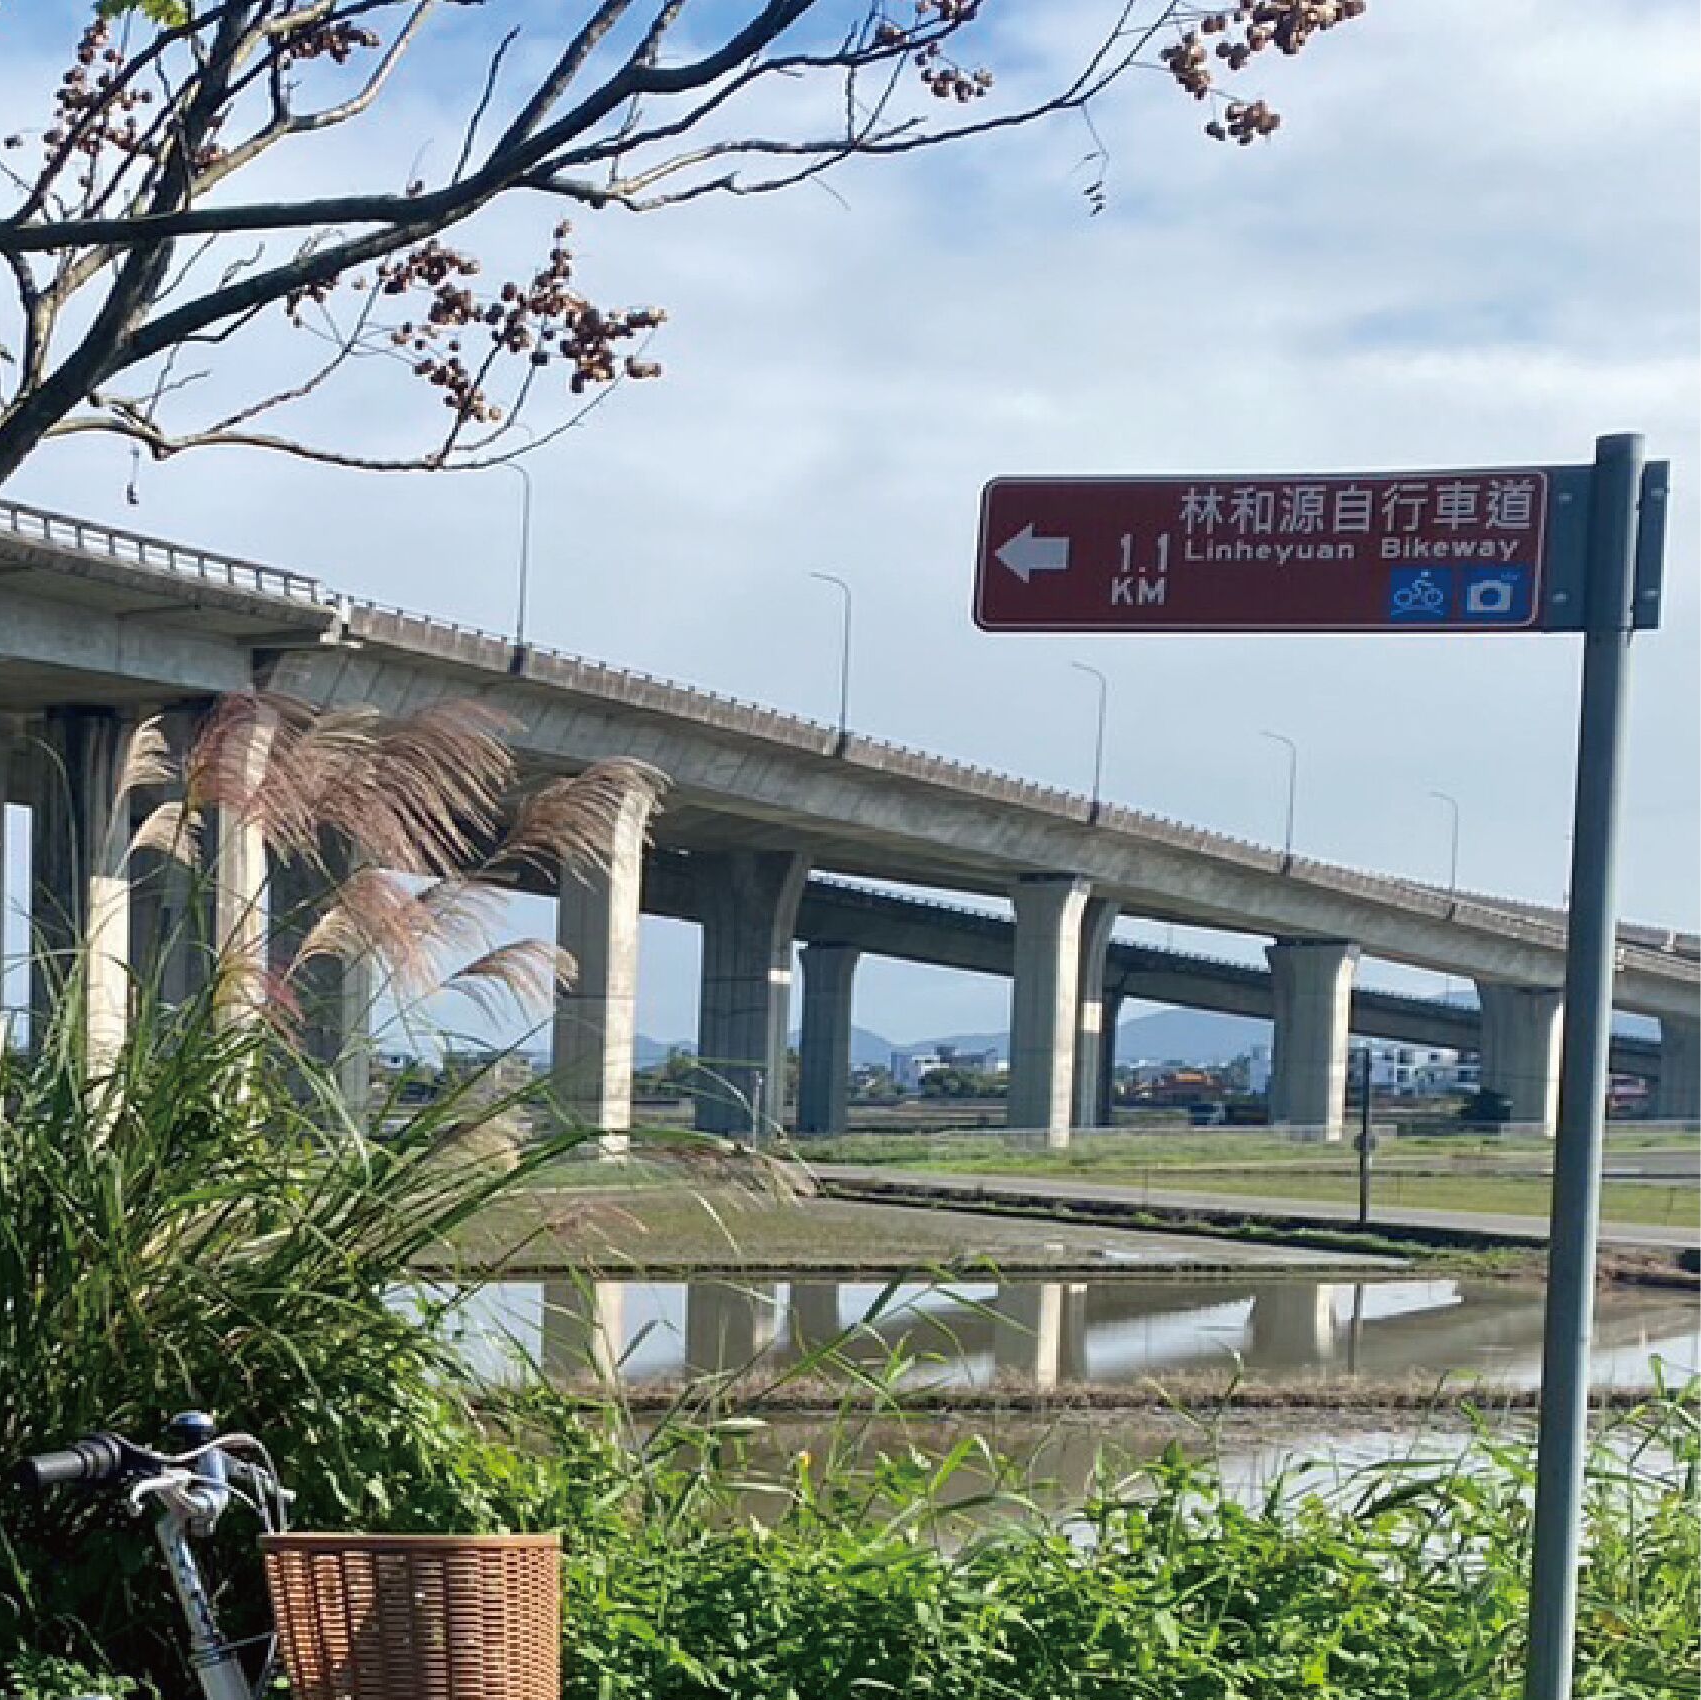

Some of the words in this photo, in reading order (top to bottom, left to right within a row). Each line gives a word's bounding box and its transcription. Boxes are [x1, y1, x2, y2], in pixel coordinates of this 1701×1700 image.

[1179, 480, 1536, 534] 林和源自行車道
[1120, 533, 1170, 573] 1.1
[1185, 538, 1355, 567] Linheyuan
[1381, 537, 1520, 562] Bikeway
[1111, 577, 1166, 605] KM
